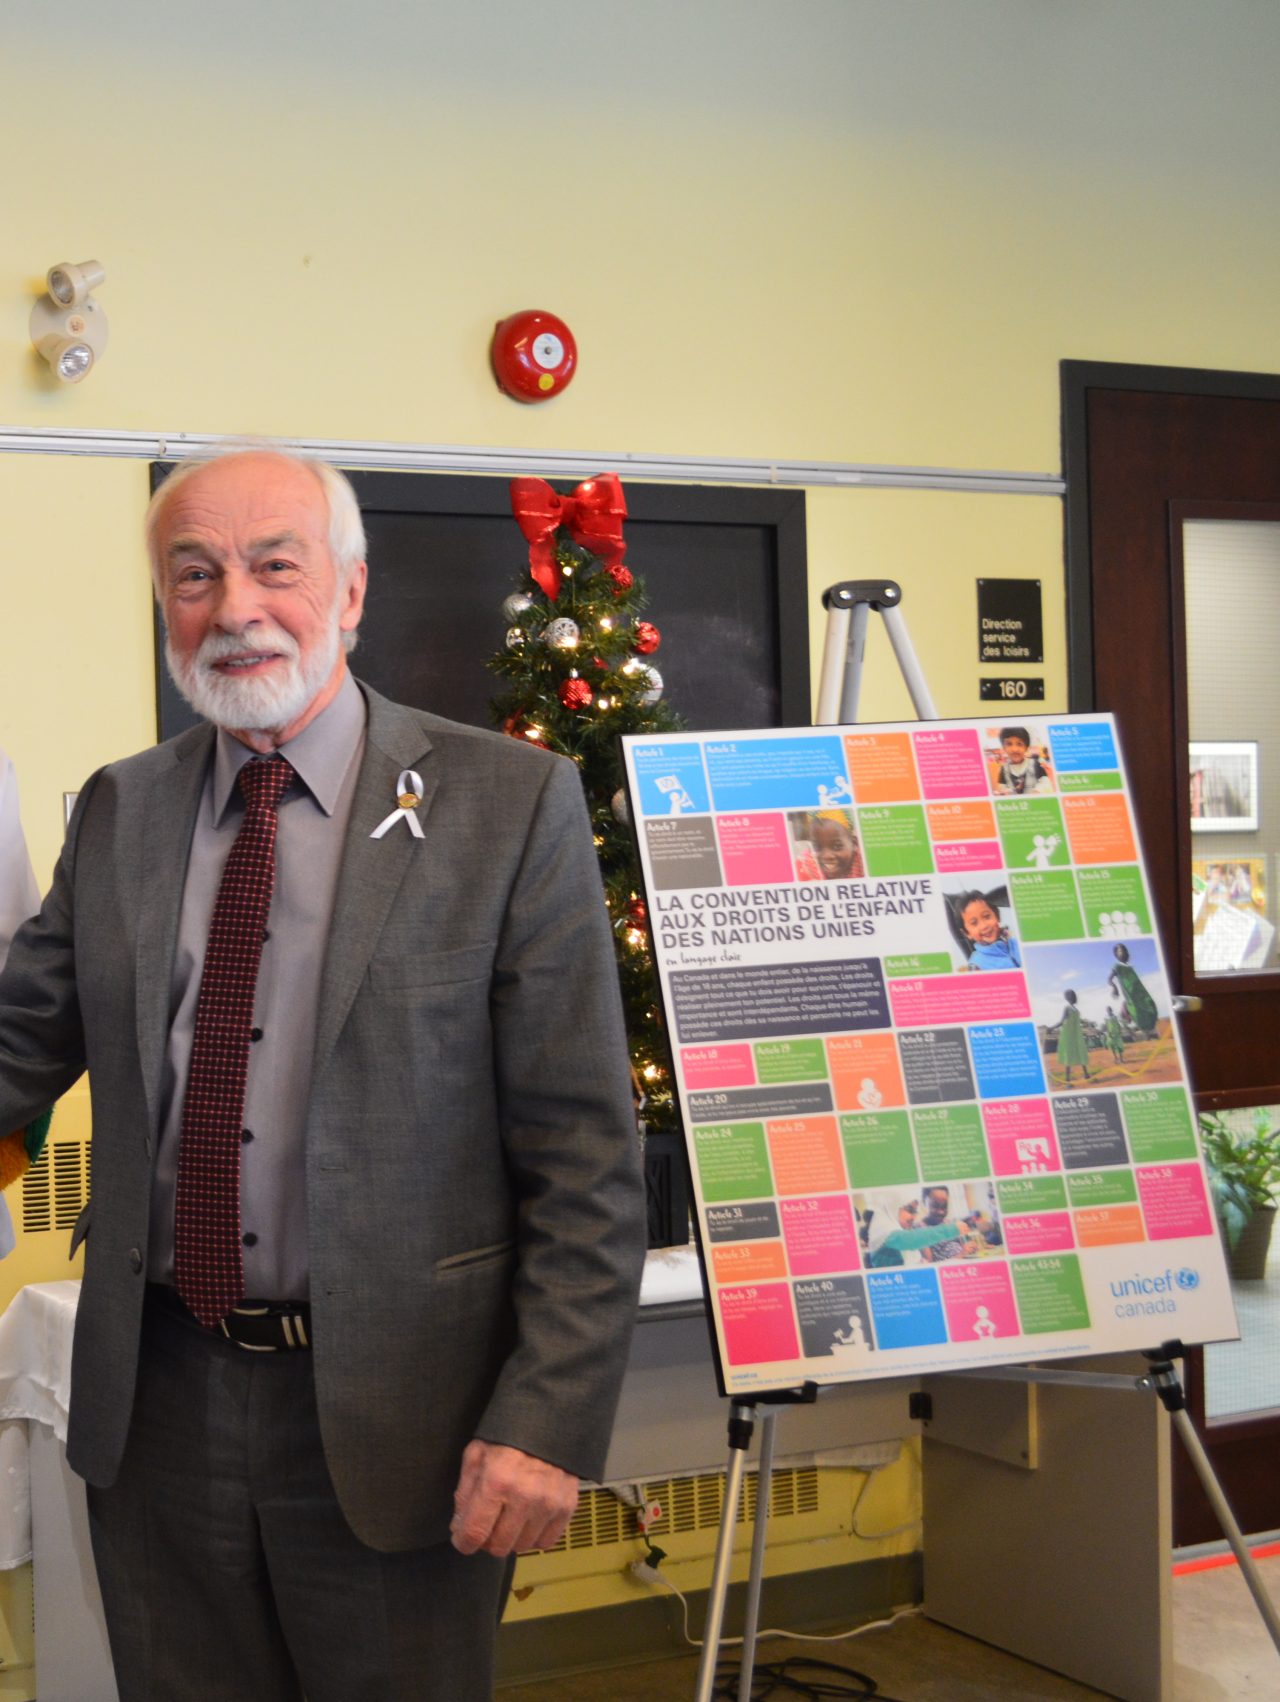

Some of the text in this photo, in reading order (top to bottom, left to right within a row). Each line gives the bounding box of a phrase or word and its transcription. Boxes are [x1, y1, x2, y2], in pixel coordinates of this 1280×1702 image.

[982, 619, 1022, 629] Direction
[983, 634, 1016, 643] service
[984, 646, 1030, 656] des loisirs
[999, 681, 1026, 697] 160
[1050, 728, 1070, 737] Article
[846, 737, 867, 747] Article
[915, 733, 937, 743] Article
[707, 744, 728, 753] Article
[635, 749, 658, 758] Article
[1060, 776, 1081, 785] Article
[998, 803, 1019, 812] Article
[1065, 799, 1085, 808] Article
[860, 810, 883, 819] Article
[928, 806, 947, 816] Article
[647, 822, 670, 831] Article
[719, 818, 741, 827] Article
[936, 847, 956, 856] Article
[1078, 871, 1099, 880] Article
[1011, 876, 1032, 885] Article
[656, 880, 933, 912] LA CONVENTION RELATIVE
[660, 898, 925, 931] AUX DROITS DE L'ENFANT
[662, 920, 875, 949] DES NATIONS UNIES
[666, 956, 678, 966] en
[680, 951, 718, 966] langage
[886, 959, 907, 968] Article
[684, 974, 710, 982] Canada
[891, 982, 912, 992] Article
[970, 1029, 991, 1038] Article
[900, 1034, 923, 1044] Article
[756, 1044, 780, 1055] Article
[829, 1041, 852, 1050] Article
[683, 1050, 707, 1060] Article
[690, 1095, 714, 1107] Article
[1123, 1093, 1145, 1102] Article
[1055, 1099, 1076, 1109] Article
[985, 1106, 1006, 1115] Article
[914, 1112, 935, 1121] Article
[842, 1117, 865, 1128] Article
[770, 1124, 794, 1134] Article
[695, 1130, 720, 1140] Article
[1138, 1170, 1159, 1179] Article
[1069, 1177, 1091, 1185] Article
[999, 1183, 1020, 1192] Article
[783, 1202, 806, 1212] Article
[708, 1209, 731, 1219] Article
[1076, 1213, 1097, 1222] Article
[1006, 1220, 1028, 1229] Article
[715, 1250, 738, 1260] Article
[1014, 1262, 1035, 1271] Article
[942, 1269, 966, 1279] Article
[870, 1277, 892, 1286] Article
[1111, 1271, 1173, 1297] unicef
[796, 1283, 819, 1293] Article
[721, 1291, 744, 1300] Article
[1115, 1297, 1176, 1318] canada
